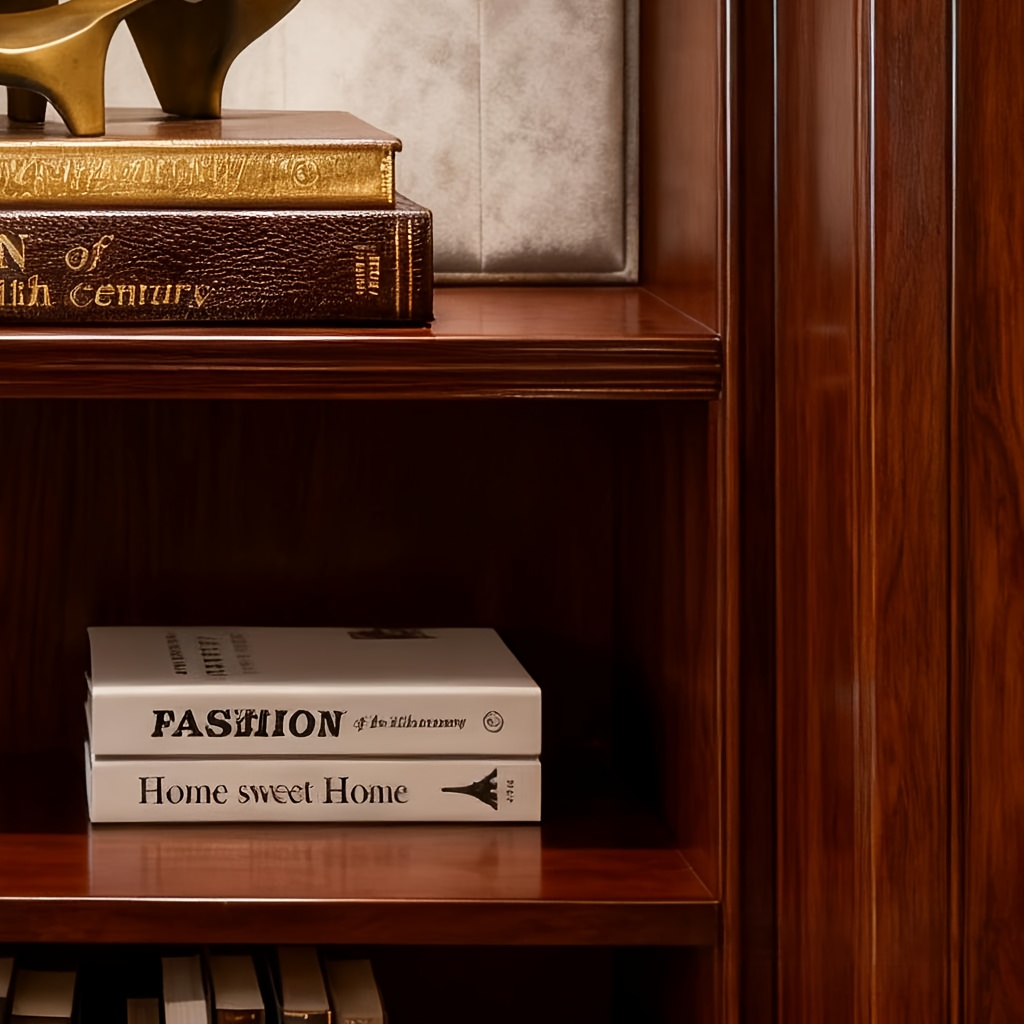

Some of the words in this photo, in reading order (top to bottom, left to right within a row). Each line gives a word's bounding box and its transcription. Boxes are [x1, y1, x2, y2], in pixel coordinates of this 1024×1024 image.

[65, 234, 115, 272] of
[138, 776, 228, 804] Home
[238, 782, 313, 804] sweet
[322, 776, 409, 804] Home
